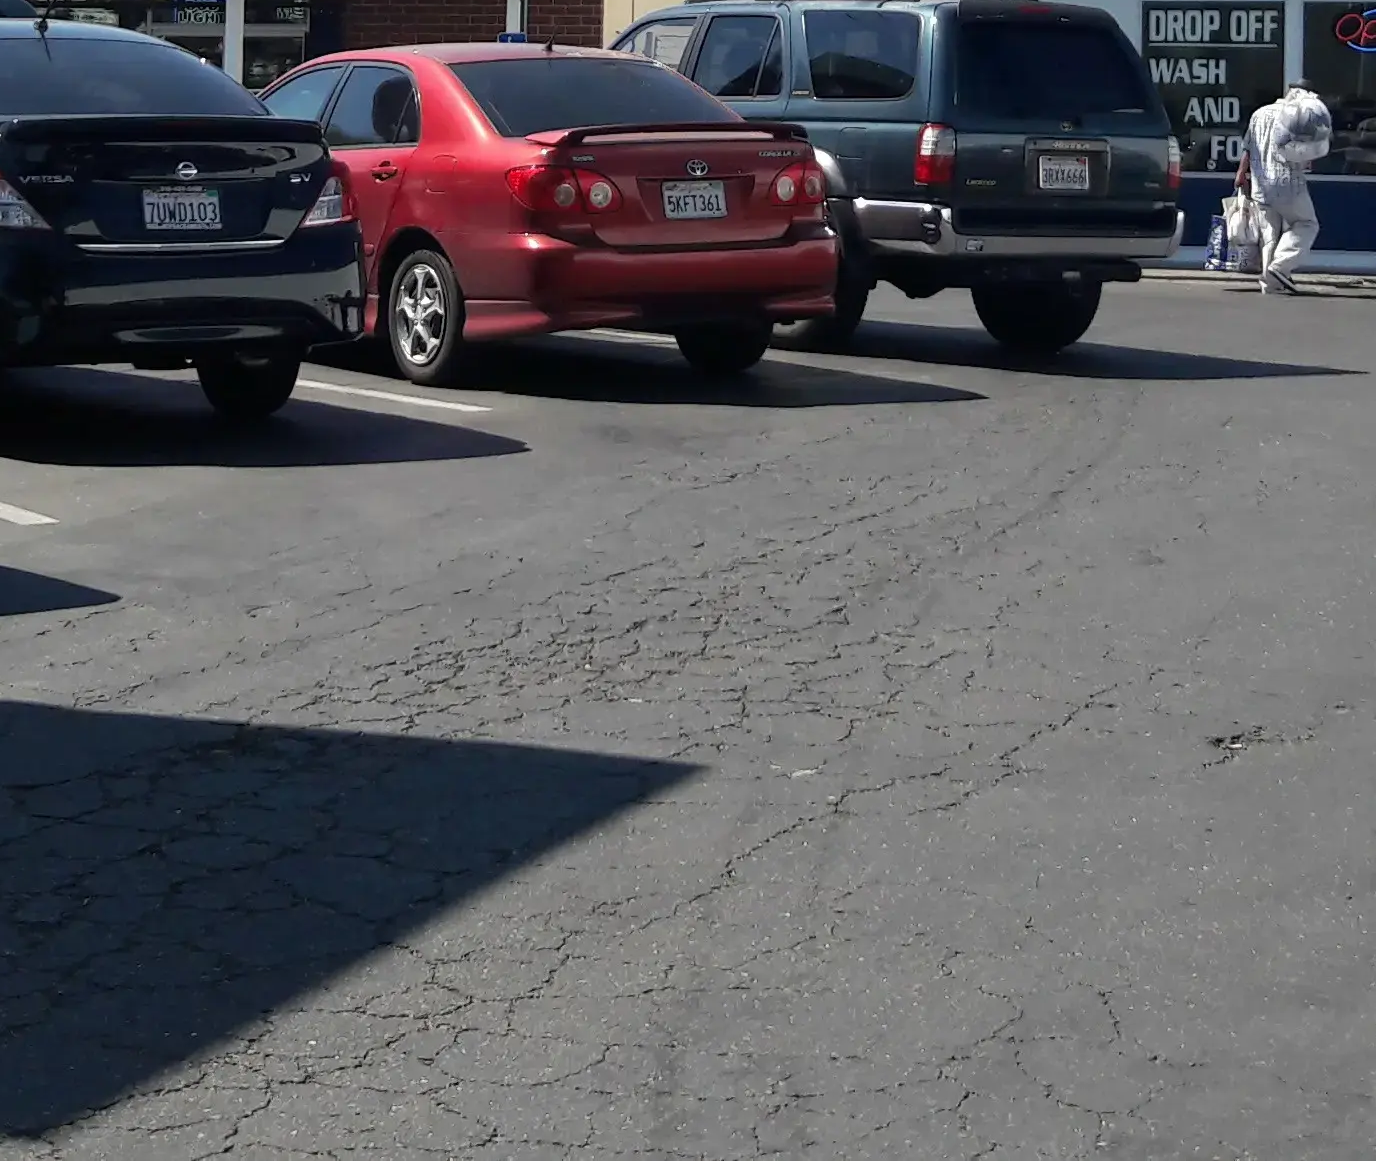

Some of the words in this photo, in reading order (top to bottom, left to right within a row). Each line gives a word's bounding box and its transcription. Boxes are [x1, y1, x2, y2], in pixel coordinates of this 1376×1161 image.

[1148, 9, 1222, 42] DROP
[1230, 9, 1279, 42] OFF
[1149, 58, 1227, 84] WASH
[1184, 96, 1240, 124] AND
[289, 172, 311, 183] SV
[146, 202, 218, 223] 7UWD103
[667, 194, 722, 214] 5KFT361
